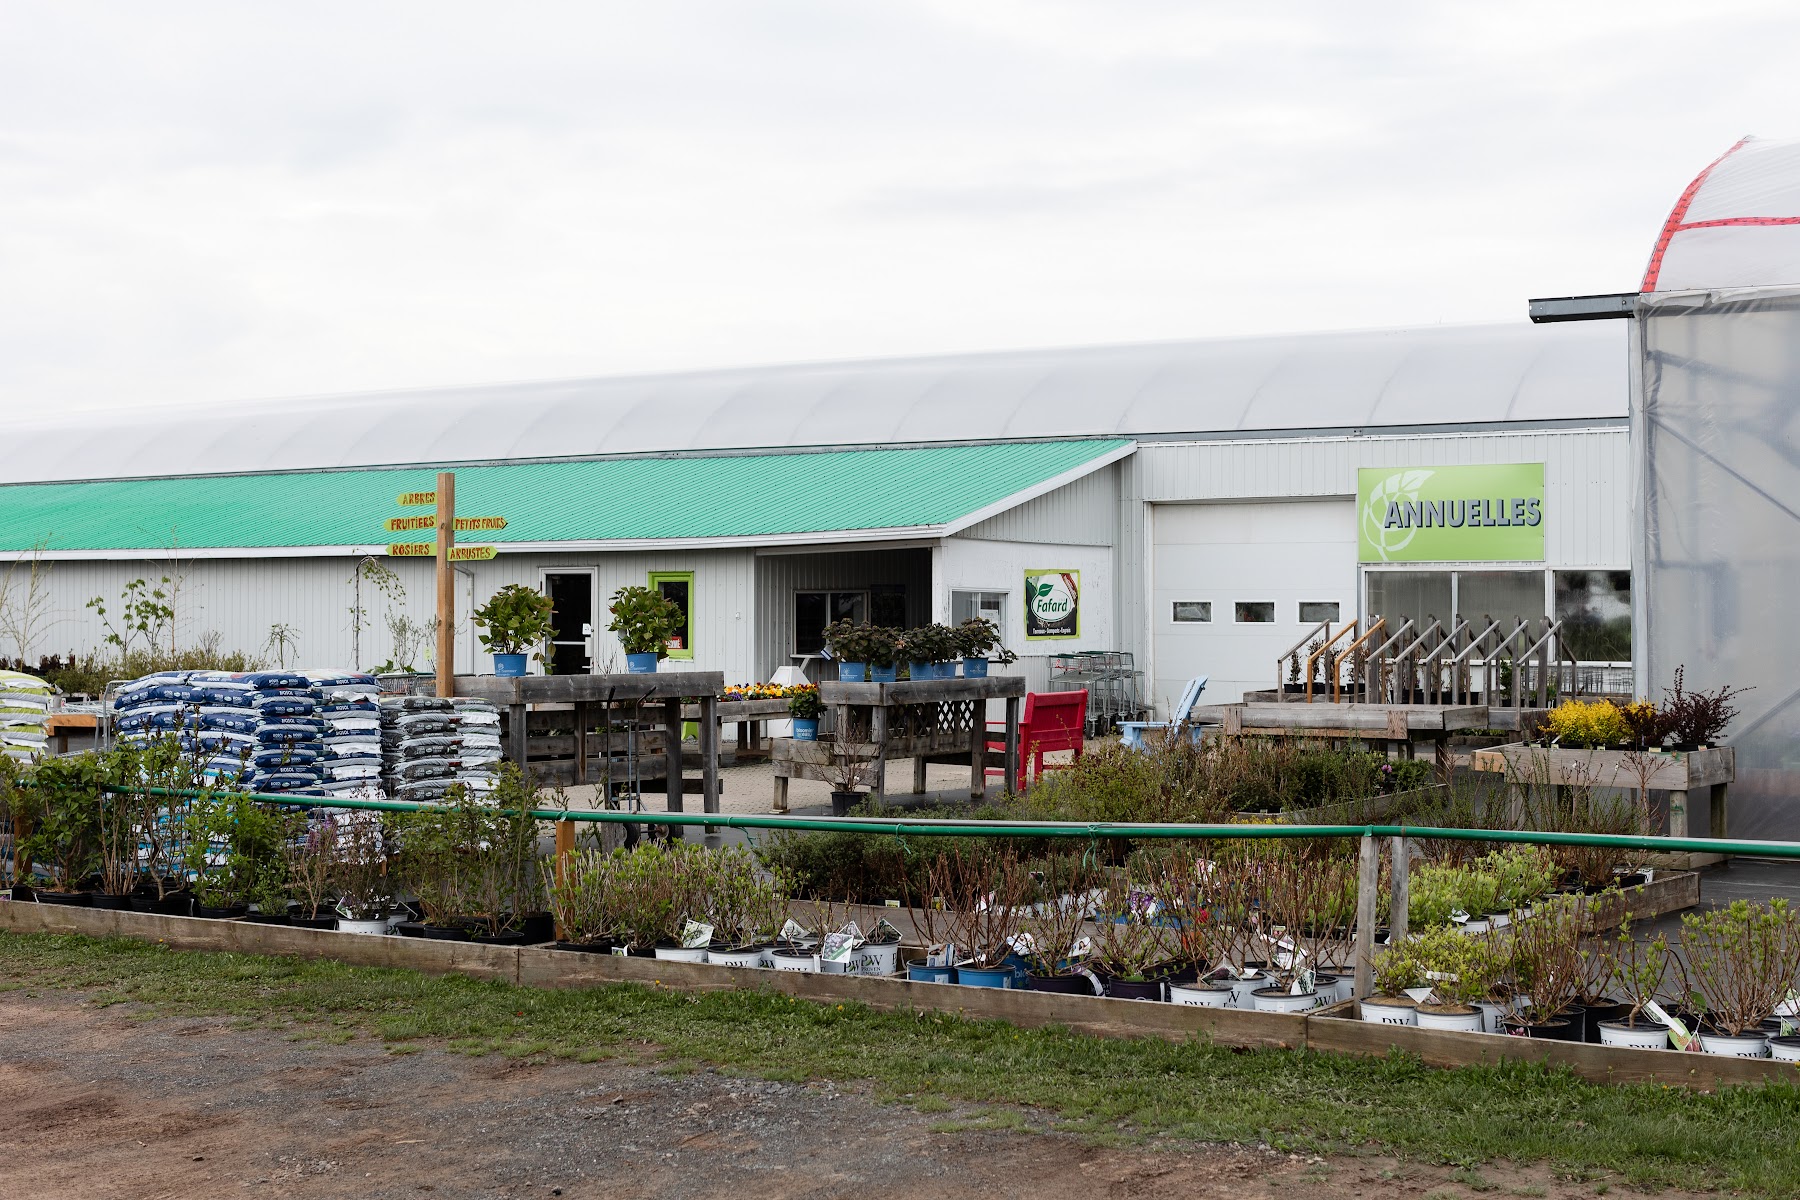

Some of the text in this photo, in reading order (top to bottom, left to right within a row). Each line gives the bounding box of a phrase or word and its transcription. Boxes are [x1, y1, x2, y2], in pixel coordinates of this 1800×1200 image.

[402, 492, 435, 504] ARBRES
[1384, 497, 1541, 529] ANNUELLES
[449, 547, 490, 559] ARBUSTES
[1036, 598, 1068, 613] Fafard
[861, 954, 883, 966] PW
